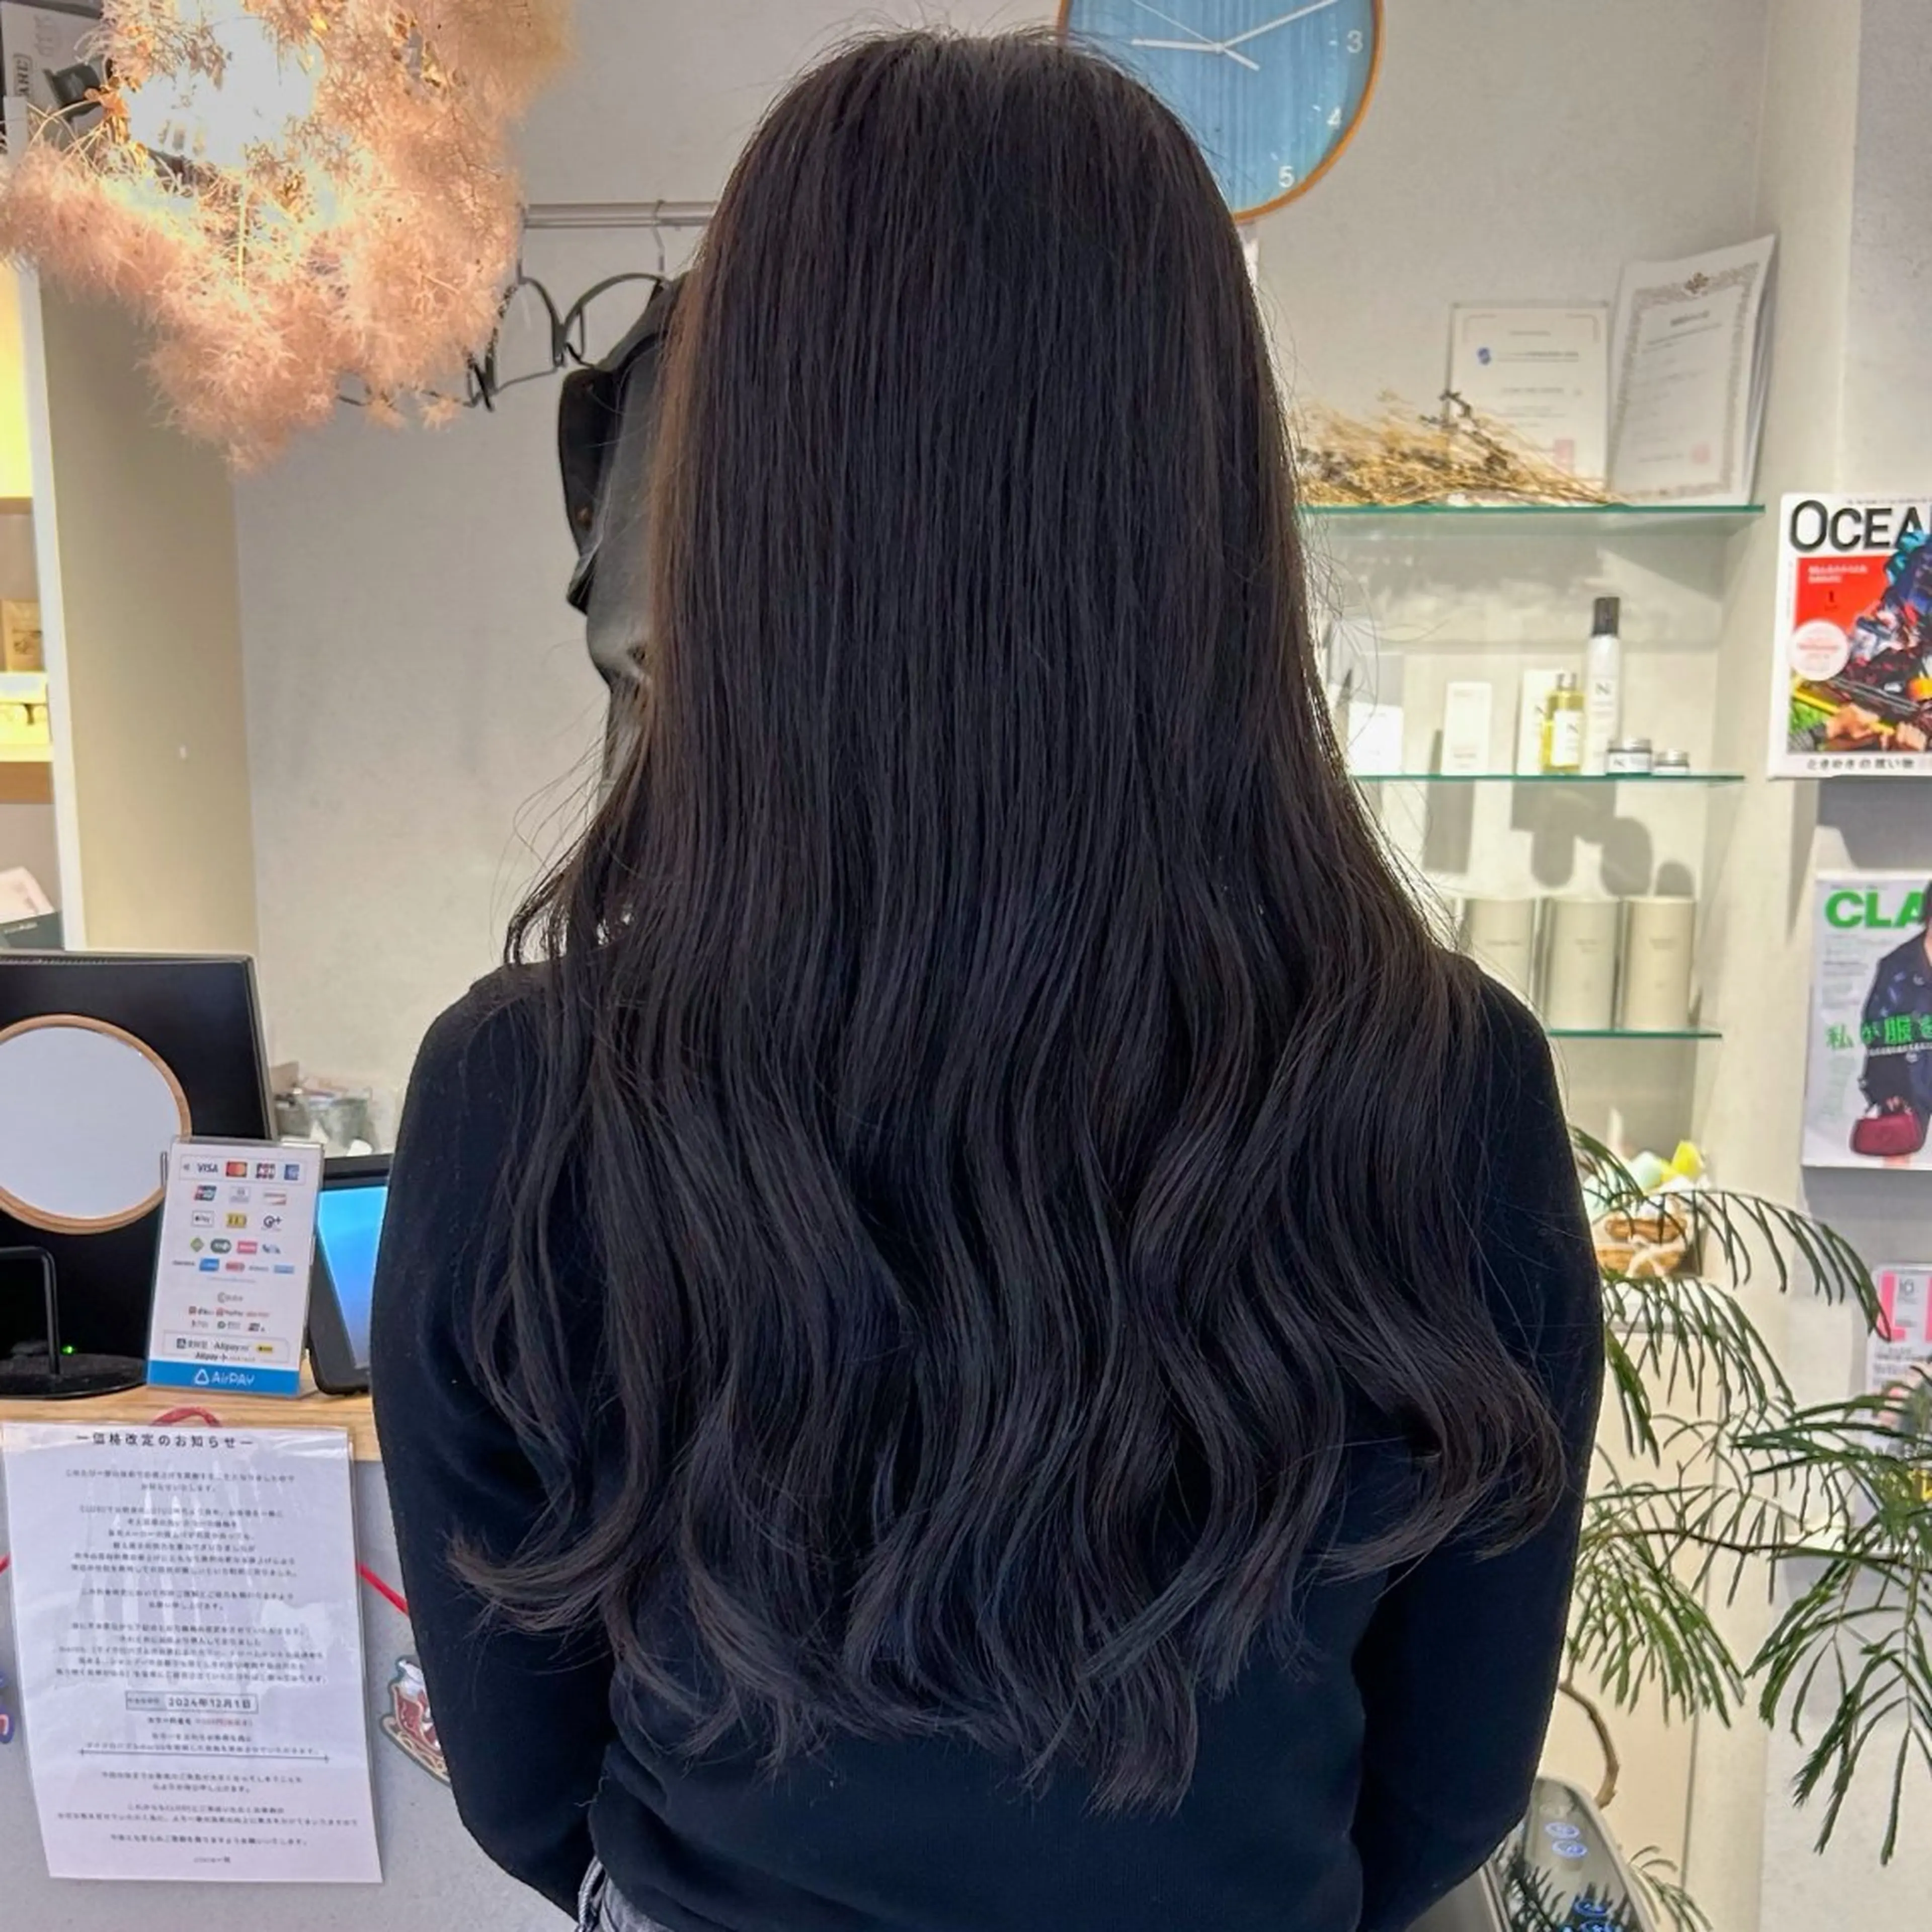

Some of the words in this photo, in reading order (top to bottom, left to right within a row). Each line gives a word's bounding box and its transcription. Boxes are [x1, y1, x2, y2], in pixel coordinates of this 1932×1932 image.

[1346, 30, 1363, 53] 3
[1327, 107, 1342, 130] 4
[1278, 166, 1295, 188] 5
[1790, 500, 1932, 552] OCEA
[197, 1163, 218, 1173] VISA
